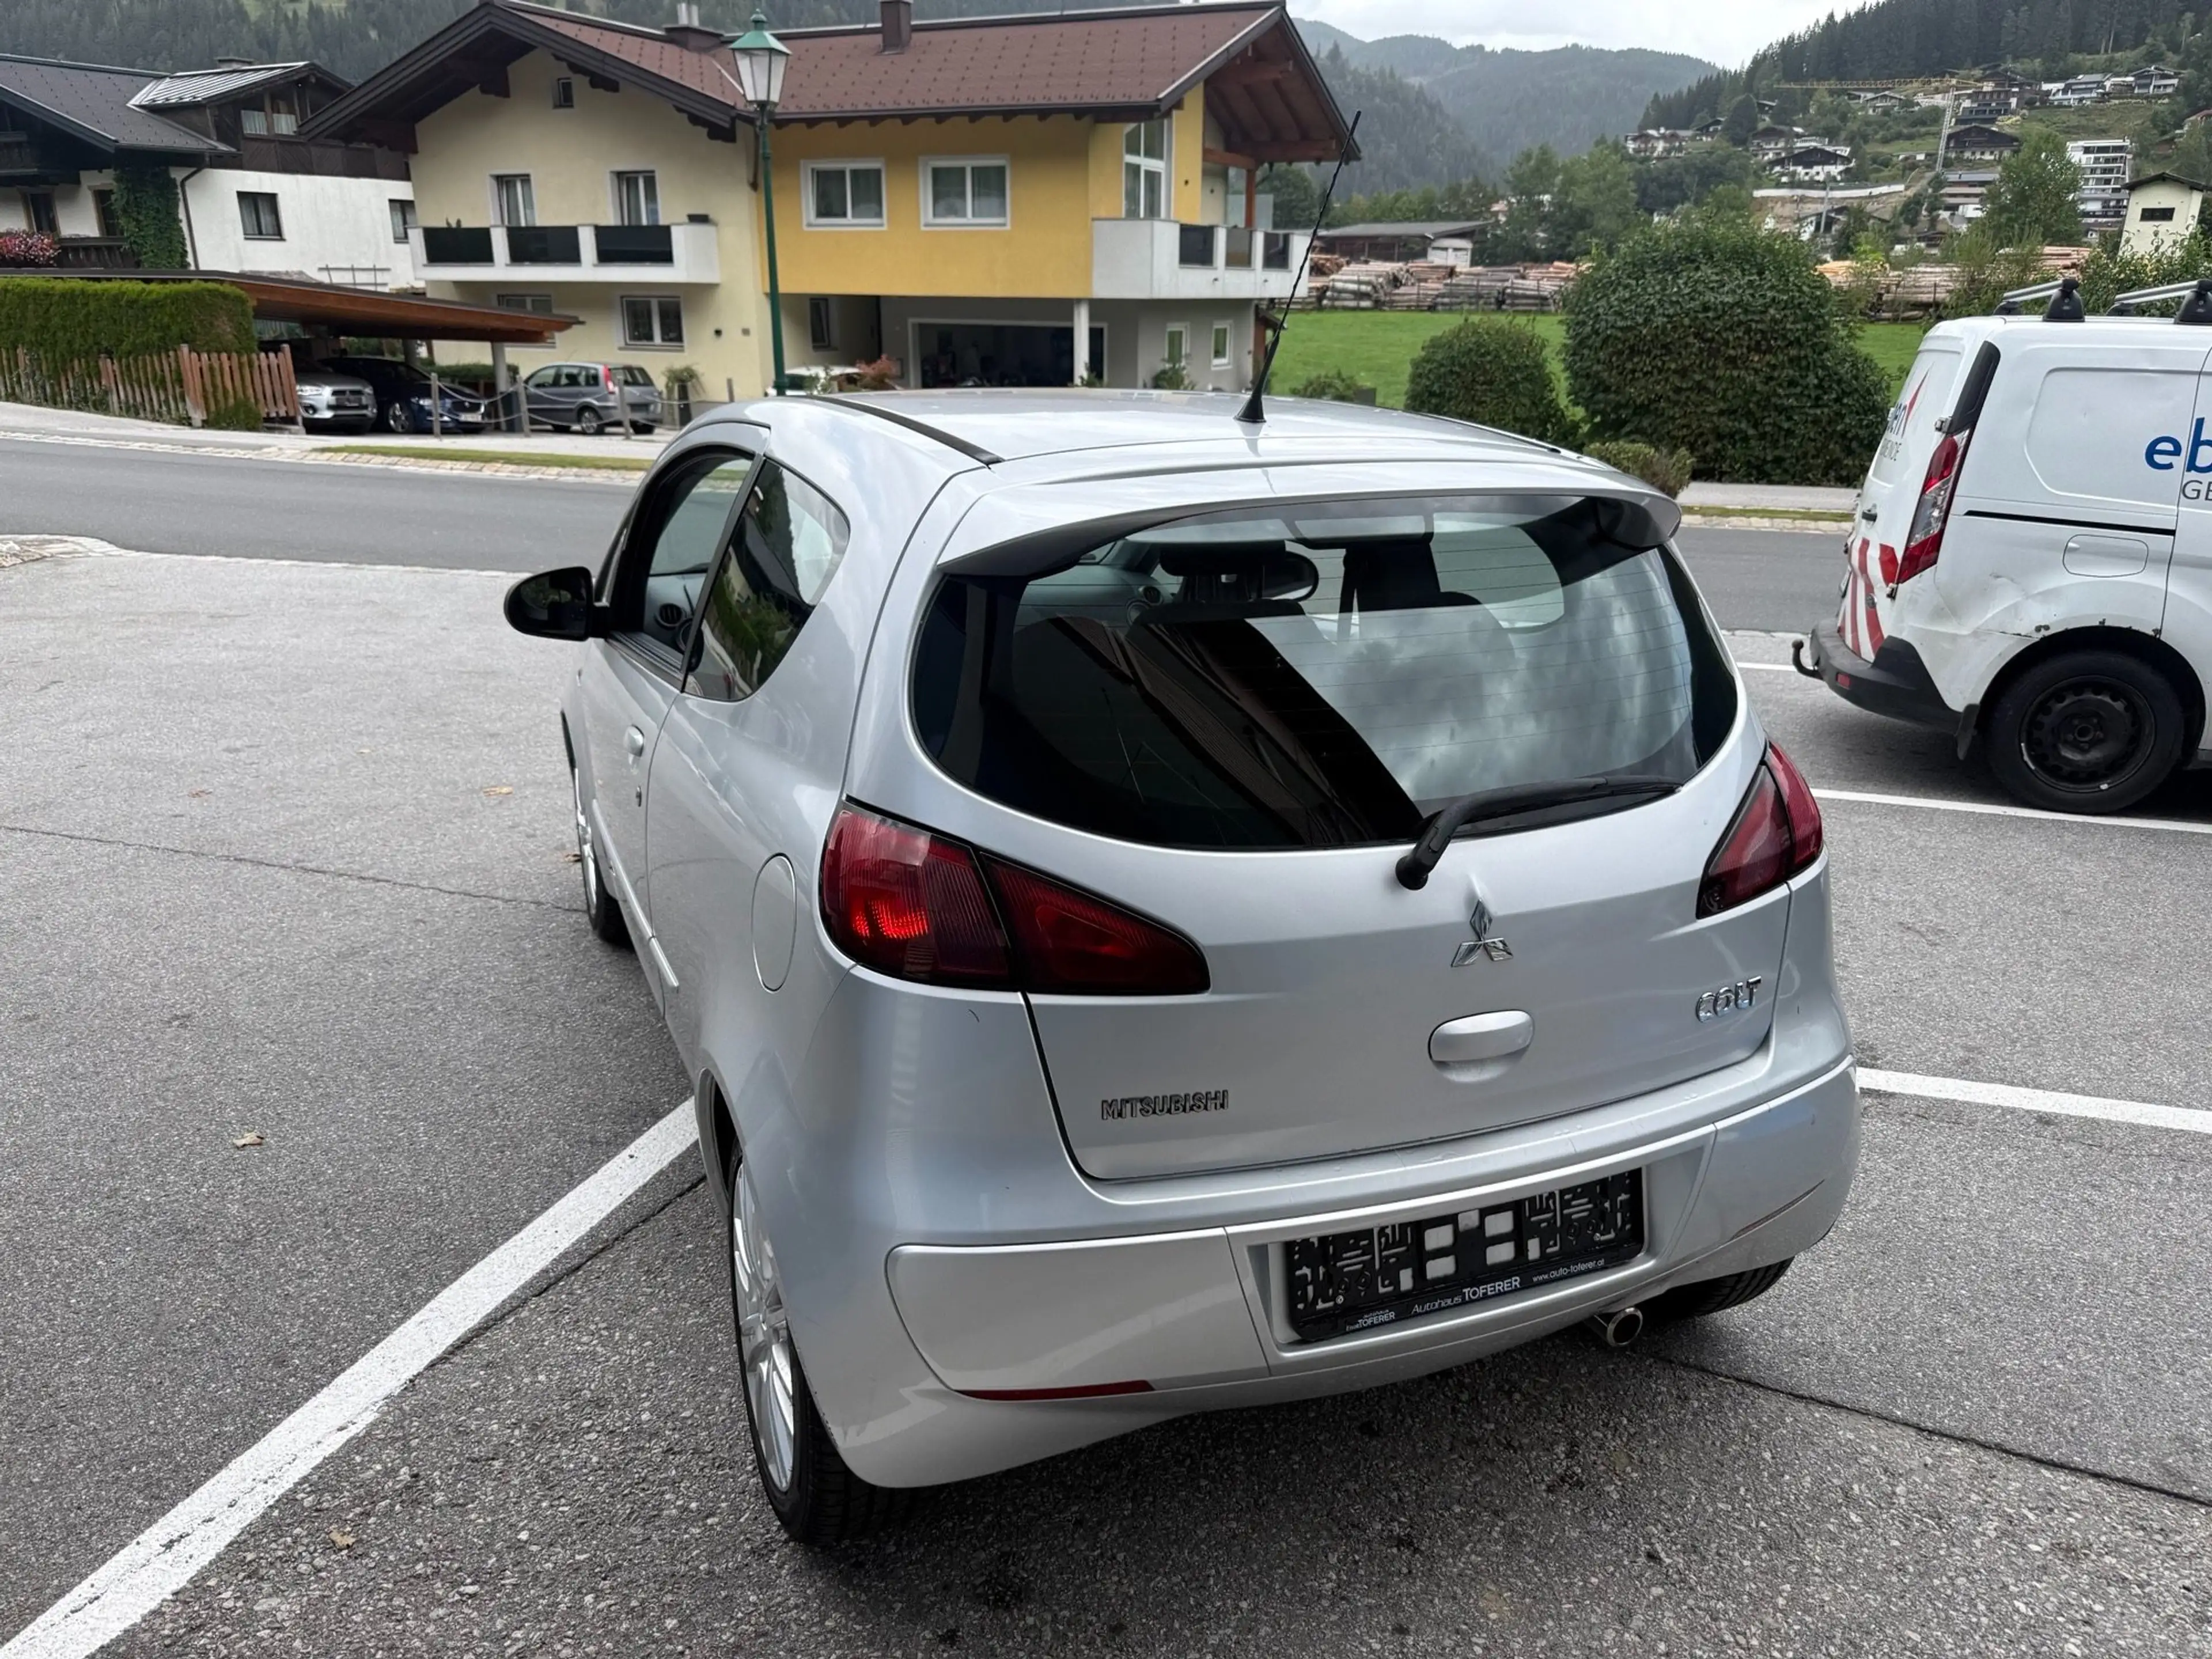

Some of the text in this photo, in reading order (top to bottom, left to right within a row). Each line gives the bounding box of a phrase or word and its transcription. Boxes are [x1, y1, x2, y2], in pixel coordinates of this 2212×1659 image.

[1696, 975, 1762, 1022] COLT
[1101, 1089, 1229, 1120] MITSUBISHI
[1411, 1277, 1520, 1314] Autohaus TOFERER
[1358, 1312, 1396, 1328] TOFERER
